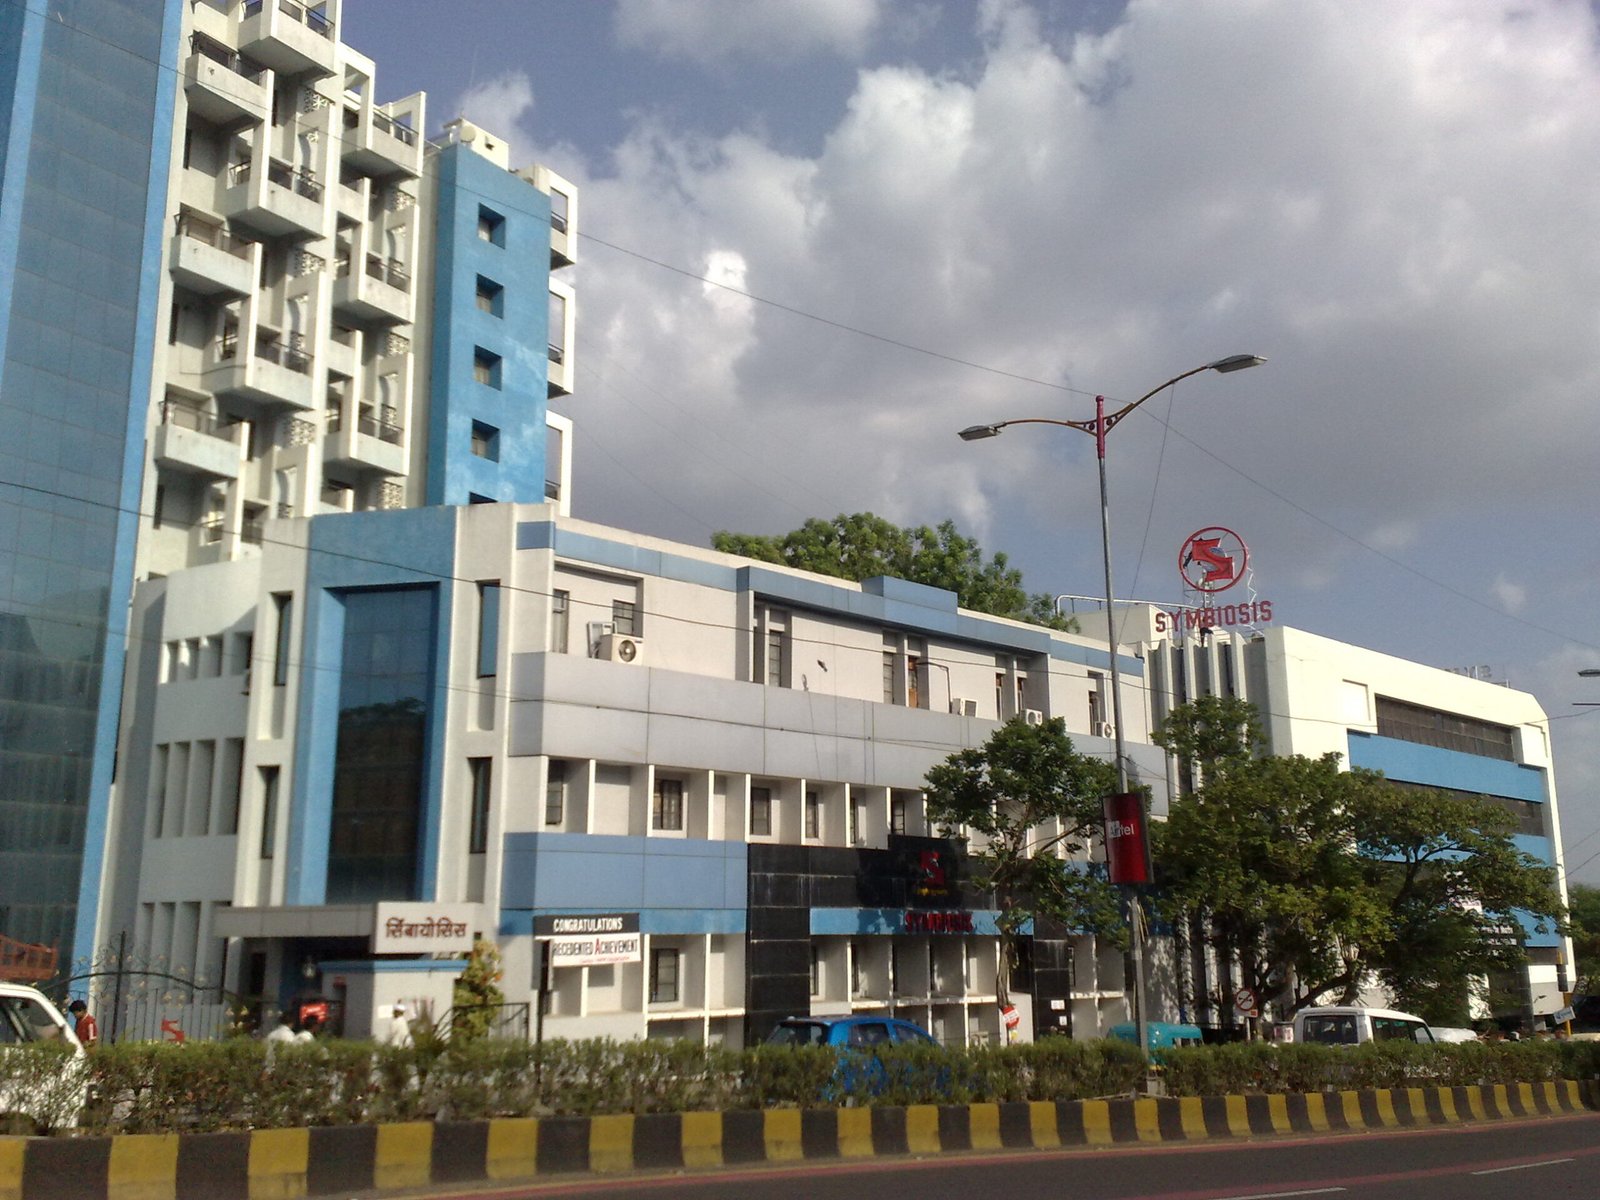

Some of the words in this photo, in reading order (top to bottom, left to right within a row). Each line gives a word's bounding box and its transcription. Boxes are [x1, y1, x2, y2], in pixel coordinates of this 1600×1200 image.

[1155, 600, 1272, 632] SYMBIOSIS
[386, 916, 468, 938] सिंबायोसिस
[553, 917, 623, 933] CONGRATULATIONS
[595, 938, 638, 955] ACHIEVEMENT
